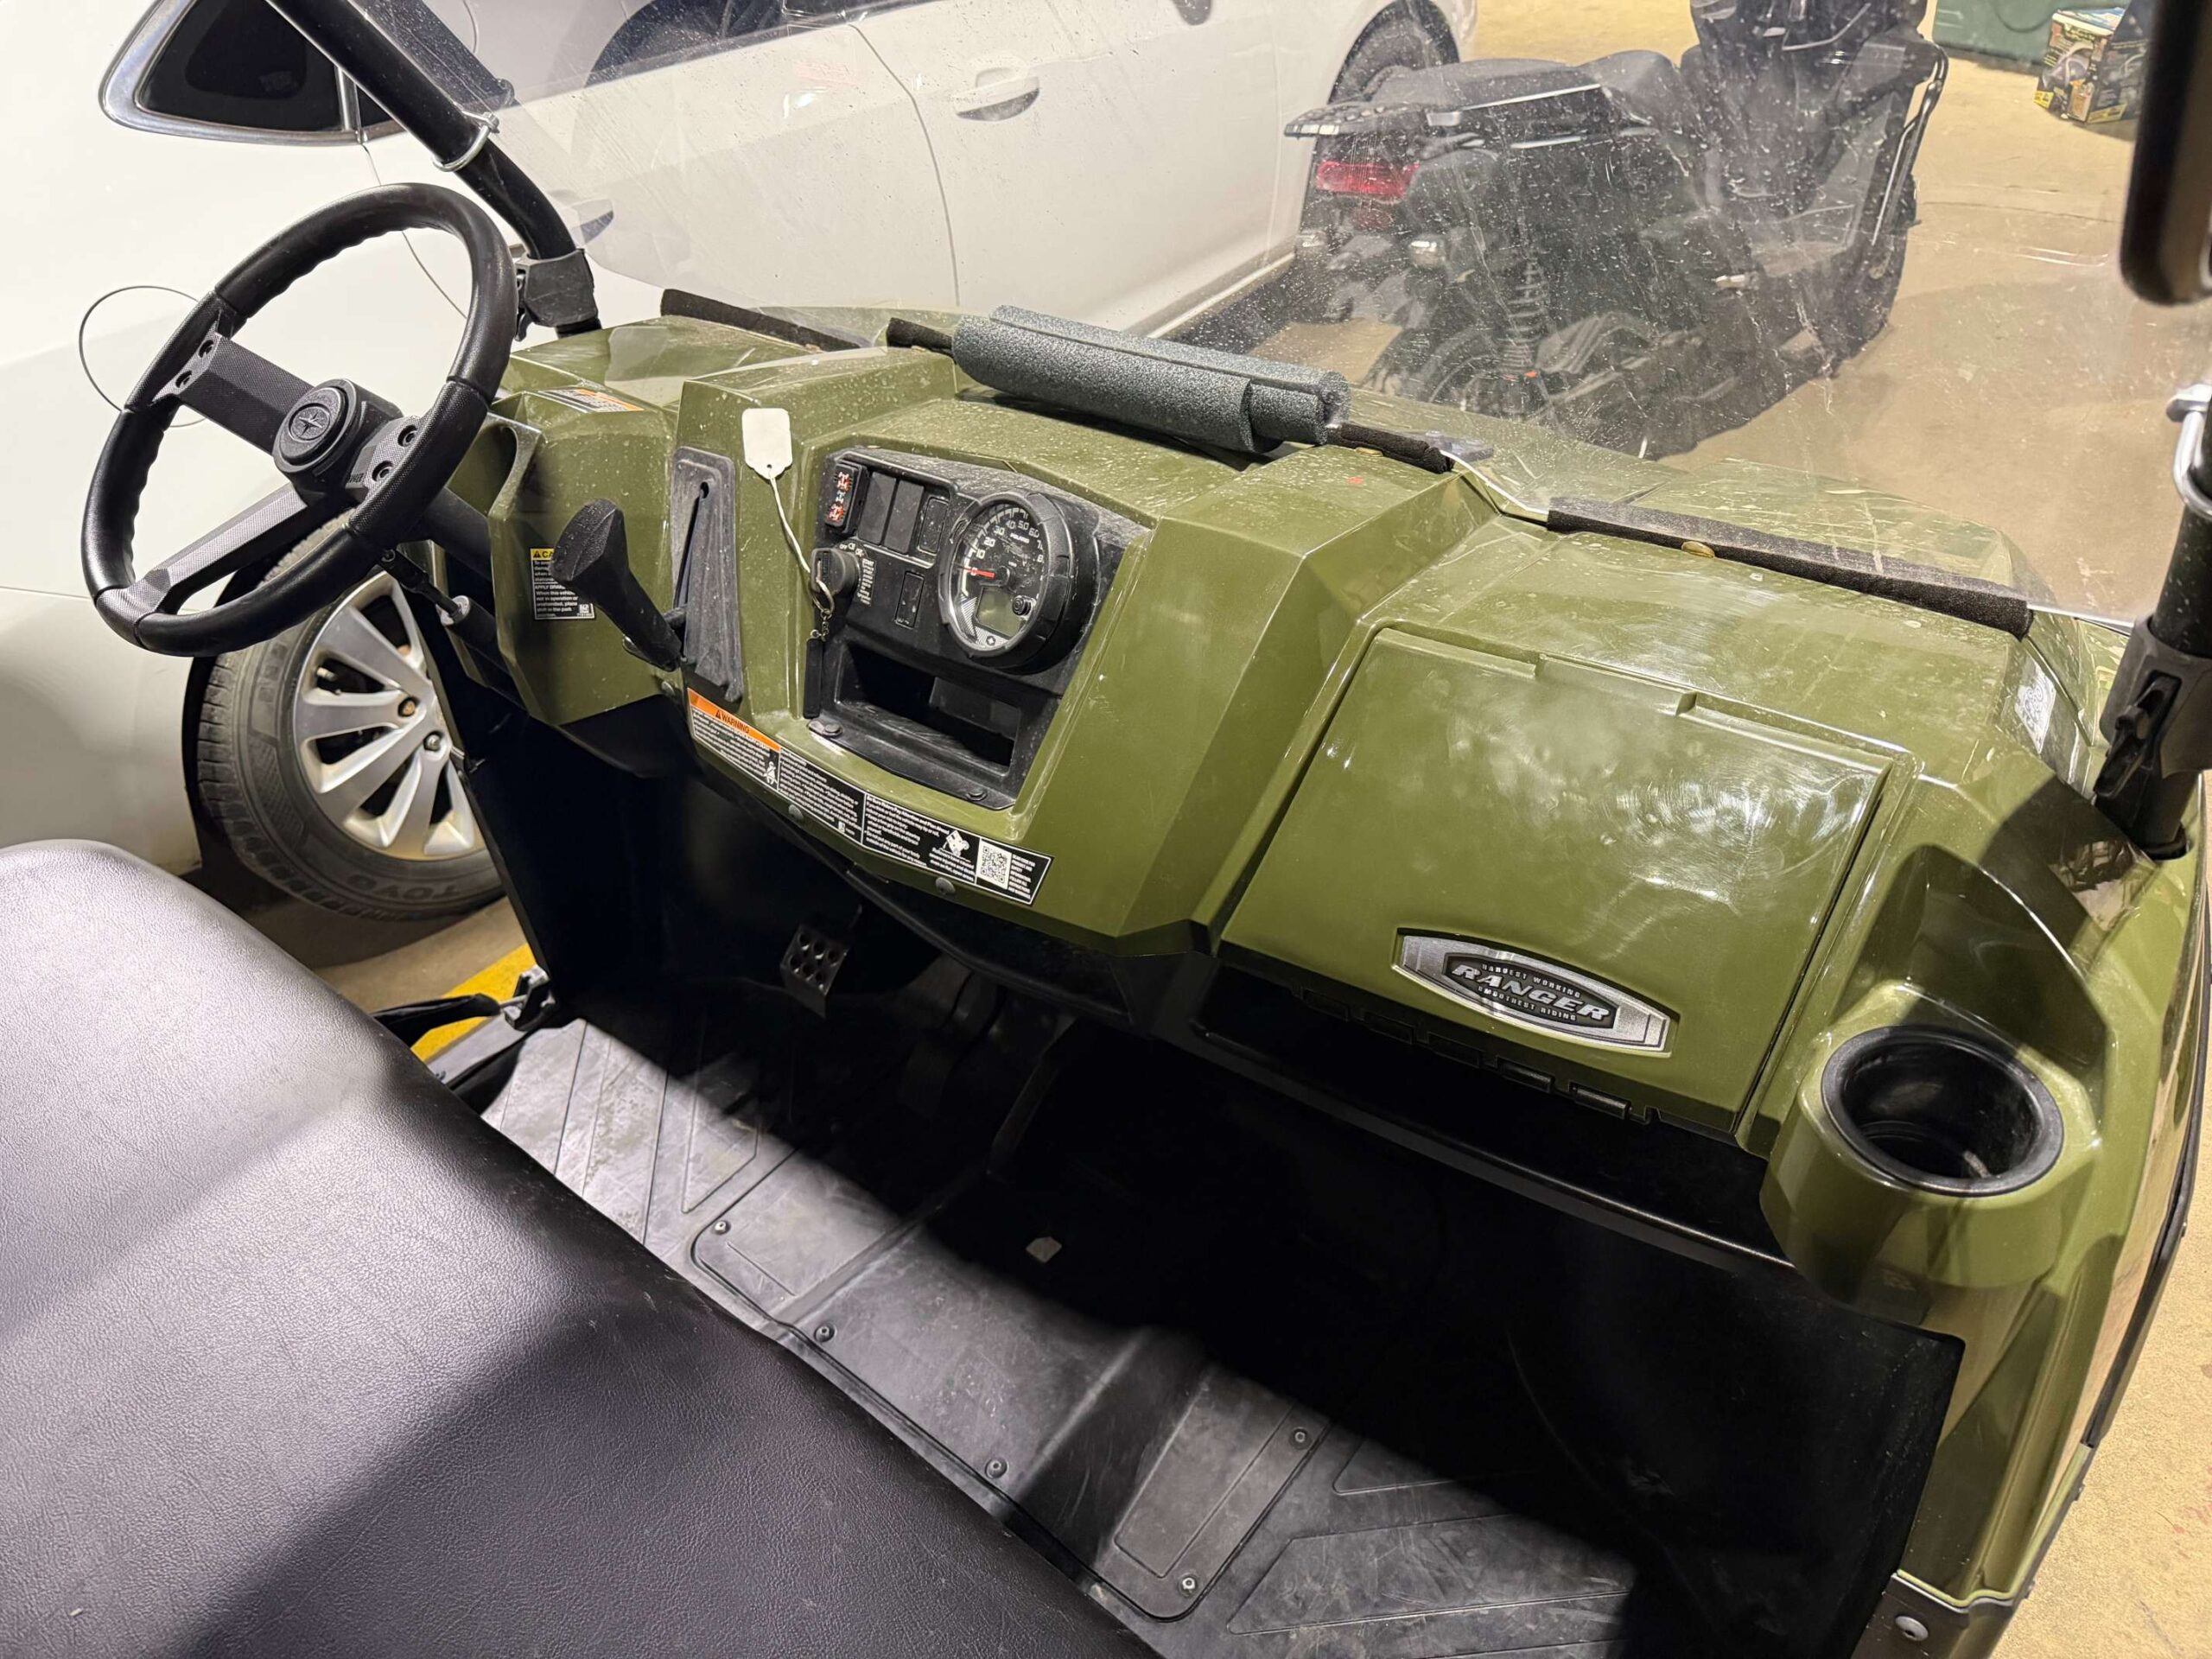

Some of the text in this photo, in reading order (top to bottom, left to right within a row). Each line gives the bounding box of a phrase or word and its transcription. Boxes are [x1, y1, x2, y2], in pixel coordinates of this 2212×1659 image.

[994, 524, 1005, 536] 30
[1006, 520, 1016, 530] 40
[1018, 520, 1029, 531] 50
[1028, 527, 1040, 538] 60
[984, 537, 996, 548] 20
[976, 549, 986, 559] 10
[722, 713, 750, 734] WARNING
[1482, 963, 1581, 999] HARDEST WORKING
[1452, 964, 1610, 1020] RANGER
[1478, 986, 1577, 1021] SMOOTHEST RIDING
